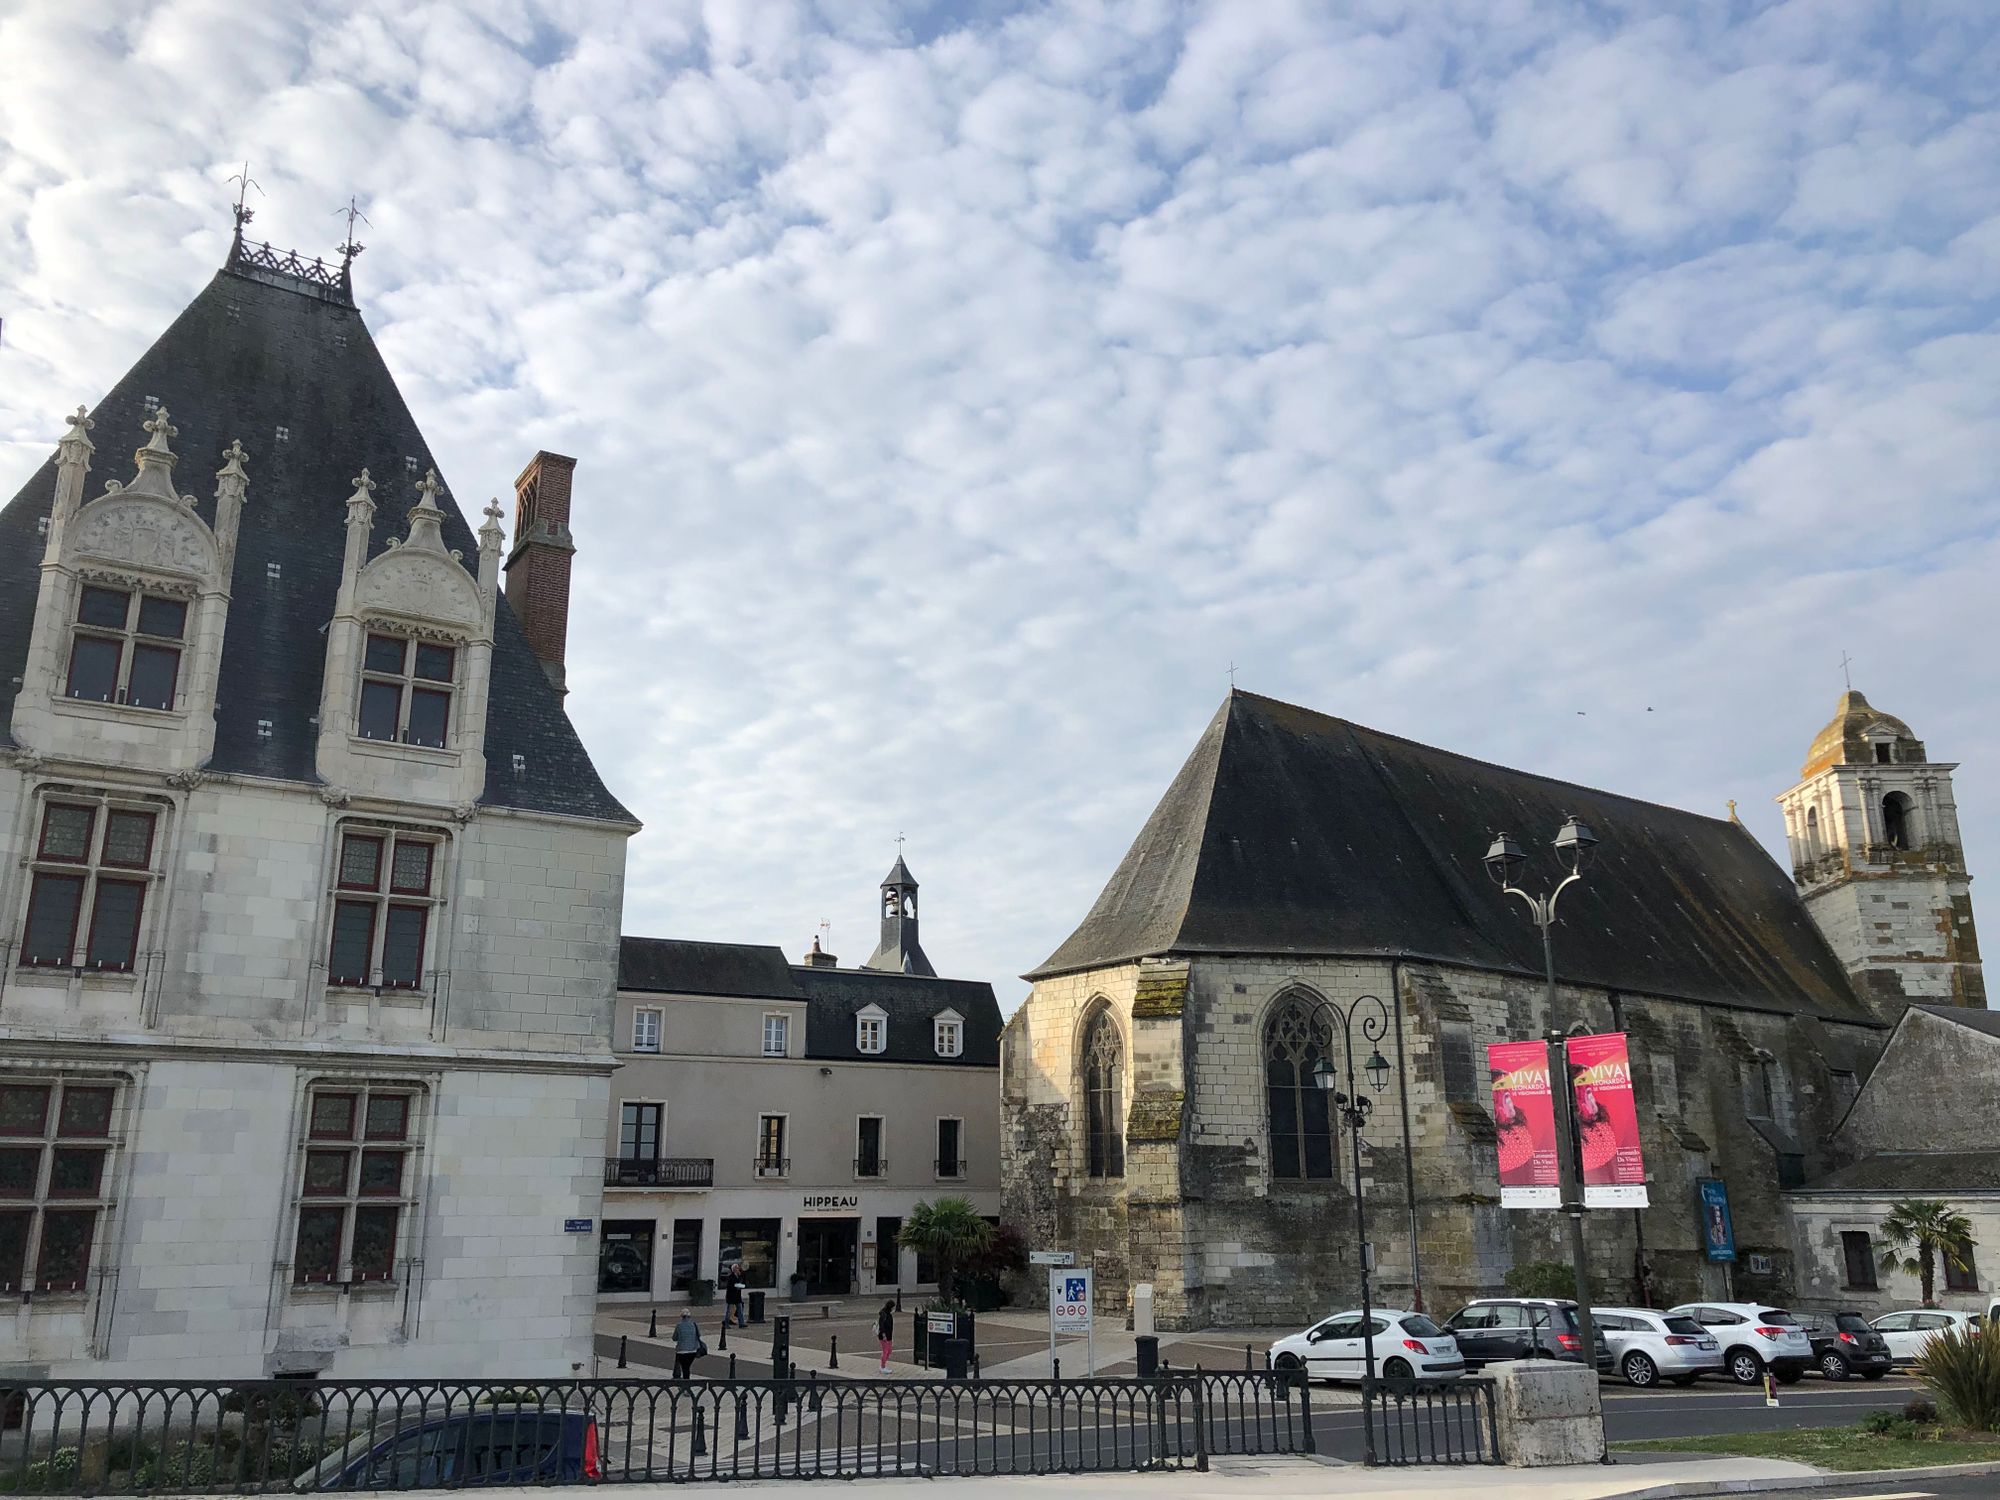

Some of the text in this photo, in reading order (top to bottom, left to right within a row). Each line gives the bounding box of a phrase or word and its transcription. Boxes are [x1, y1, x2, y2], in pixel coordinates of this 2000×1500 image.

[1592, 1077, 1625, 1086] LEONARDO
[1511, 1083, 1546, 1091] LEONARDO
[803, 1196, 858, 1207] HIPPEAU
